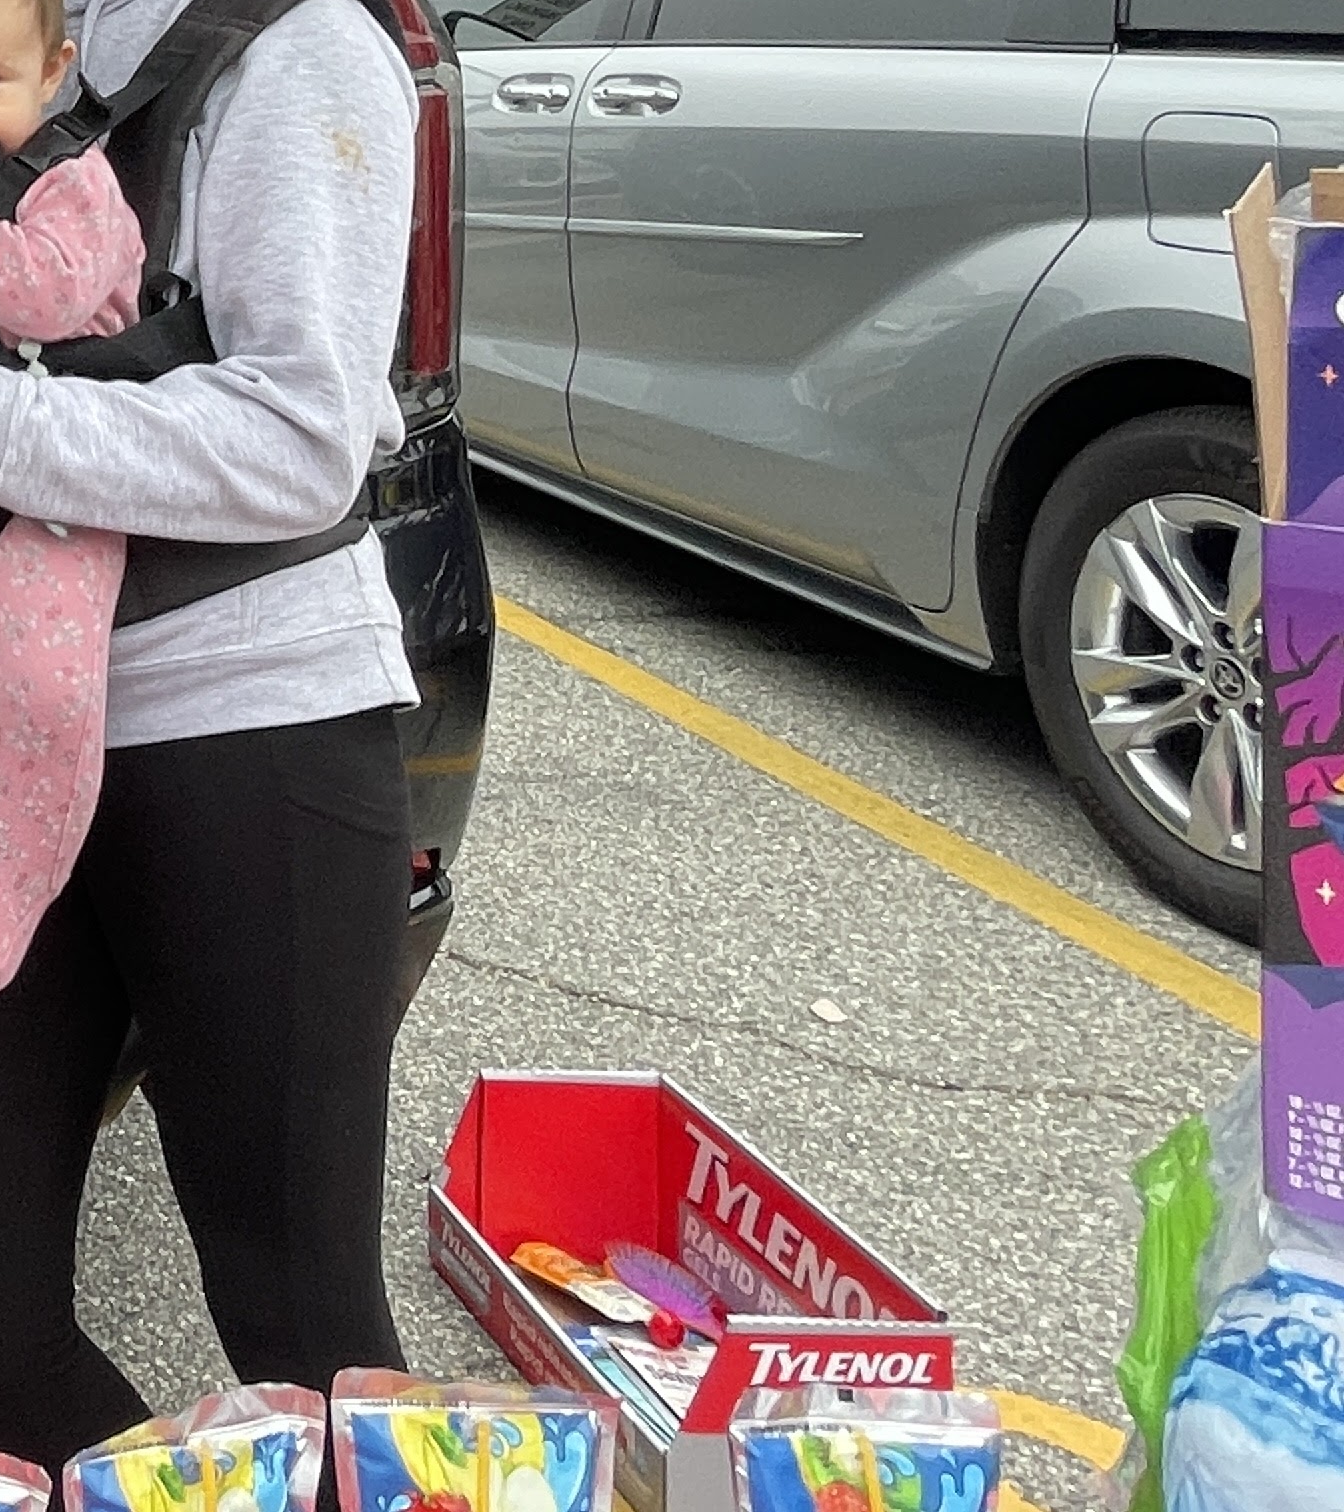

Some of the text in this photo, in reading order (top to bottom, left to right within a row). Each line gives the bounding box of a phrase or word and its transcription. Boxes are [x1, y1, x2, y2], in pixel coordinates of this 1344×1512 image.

[683, 1215, 755, 1296] RAPID
[684, 1120, 899, 1321] TYLENO
[748, 1342, 933, 1386] TYLENOL
